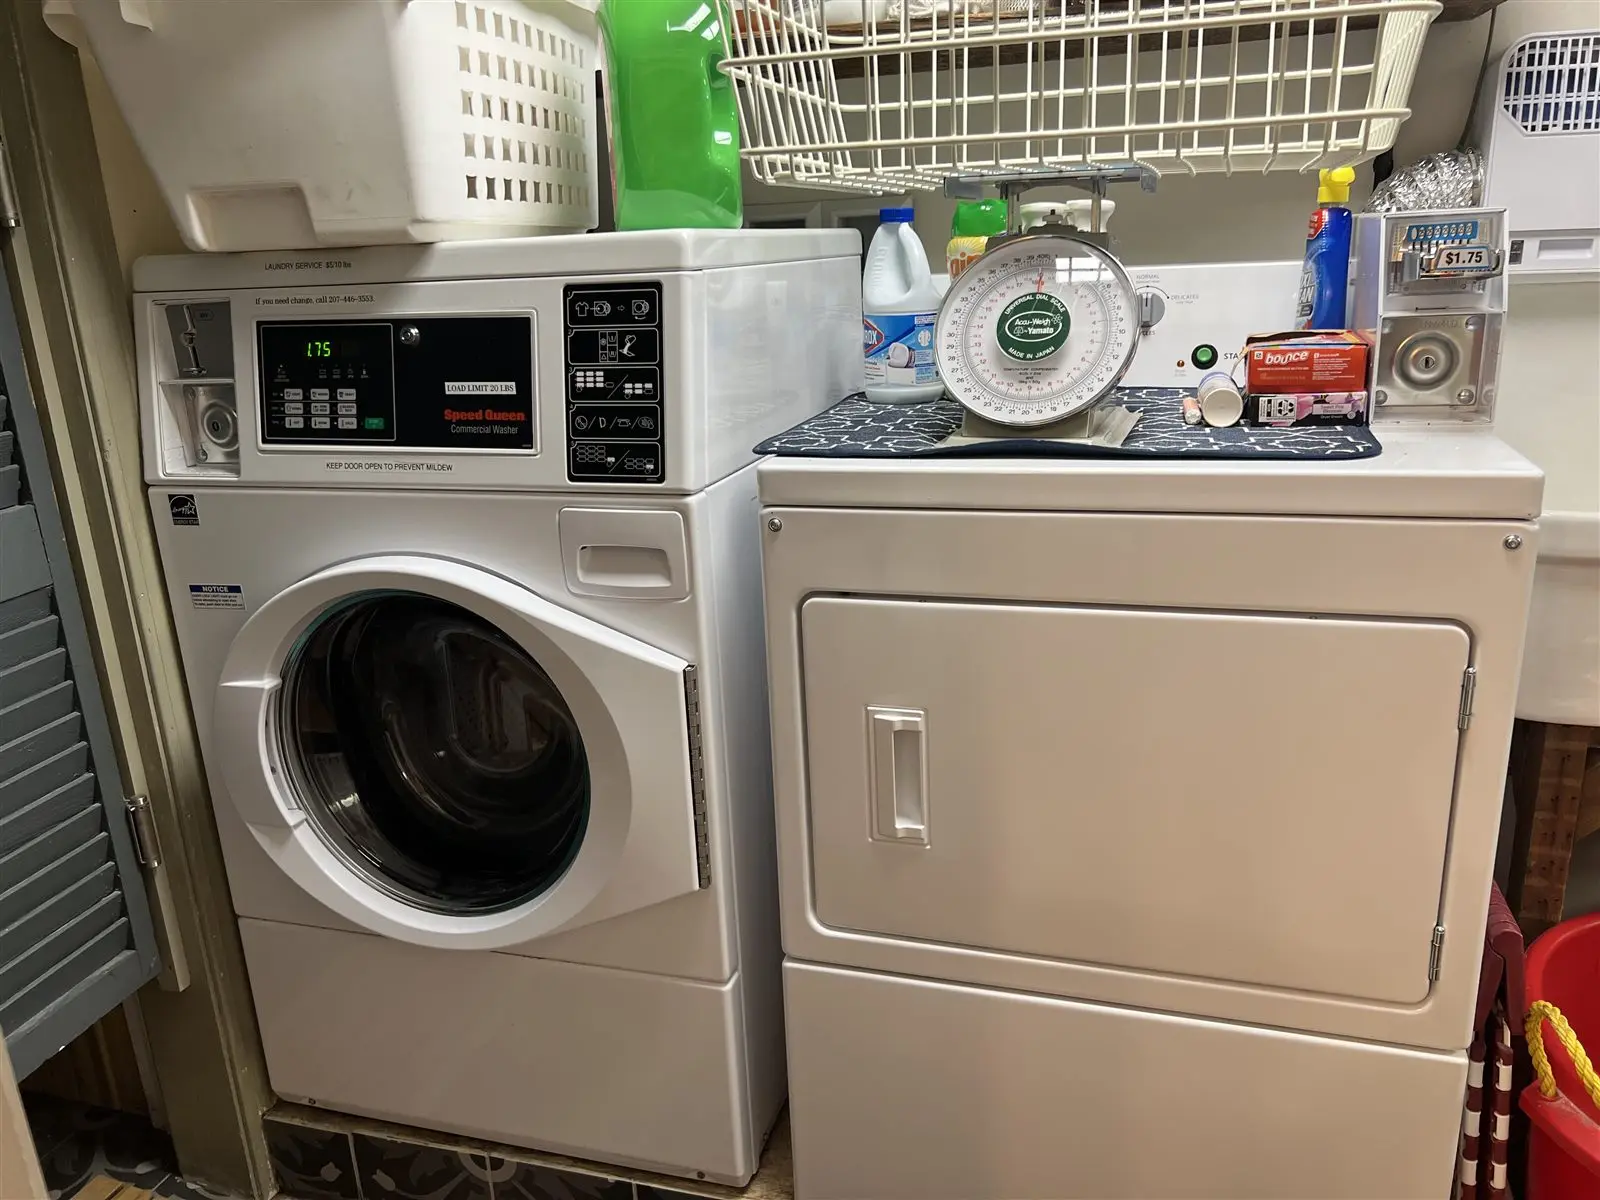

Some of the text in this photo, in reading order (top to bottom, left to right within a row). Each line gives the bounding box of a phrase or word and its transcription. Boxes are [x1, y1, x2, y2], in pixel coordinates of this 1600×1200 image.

[1445, 251, 1483, 265] $1.75
[264, 262, 293, 271] LAUNDRY
[295, 261, 323, 270] SERVICE
[262, 298, 274, 306] you
[1004, 293, 1066, 315] UNIVERSAL DIAL SCALE
[307, 342, 331, 357] 1.75
[1008, 347, 1025, 358] MADE
[1035, 346, 1055, 358] JAPAN
[1265, 351, 1308, 365] bounce
[447, 384, 466, 392] LOAD
[467, 384, 488, 392] LIMIT
[444, 409, 525, 422] Speed Queen
[450, 424, 518, 434] Commercial Washer
[326, 462, 343, 470] KEEP
[344, 462, 363, 470] DOOR
[394, 463, 424, 471] PREVENT
